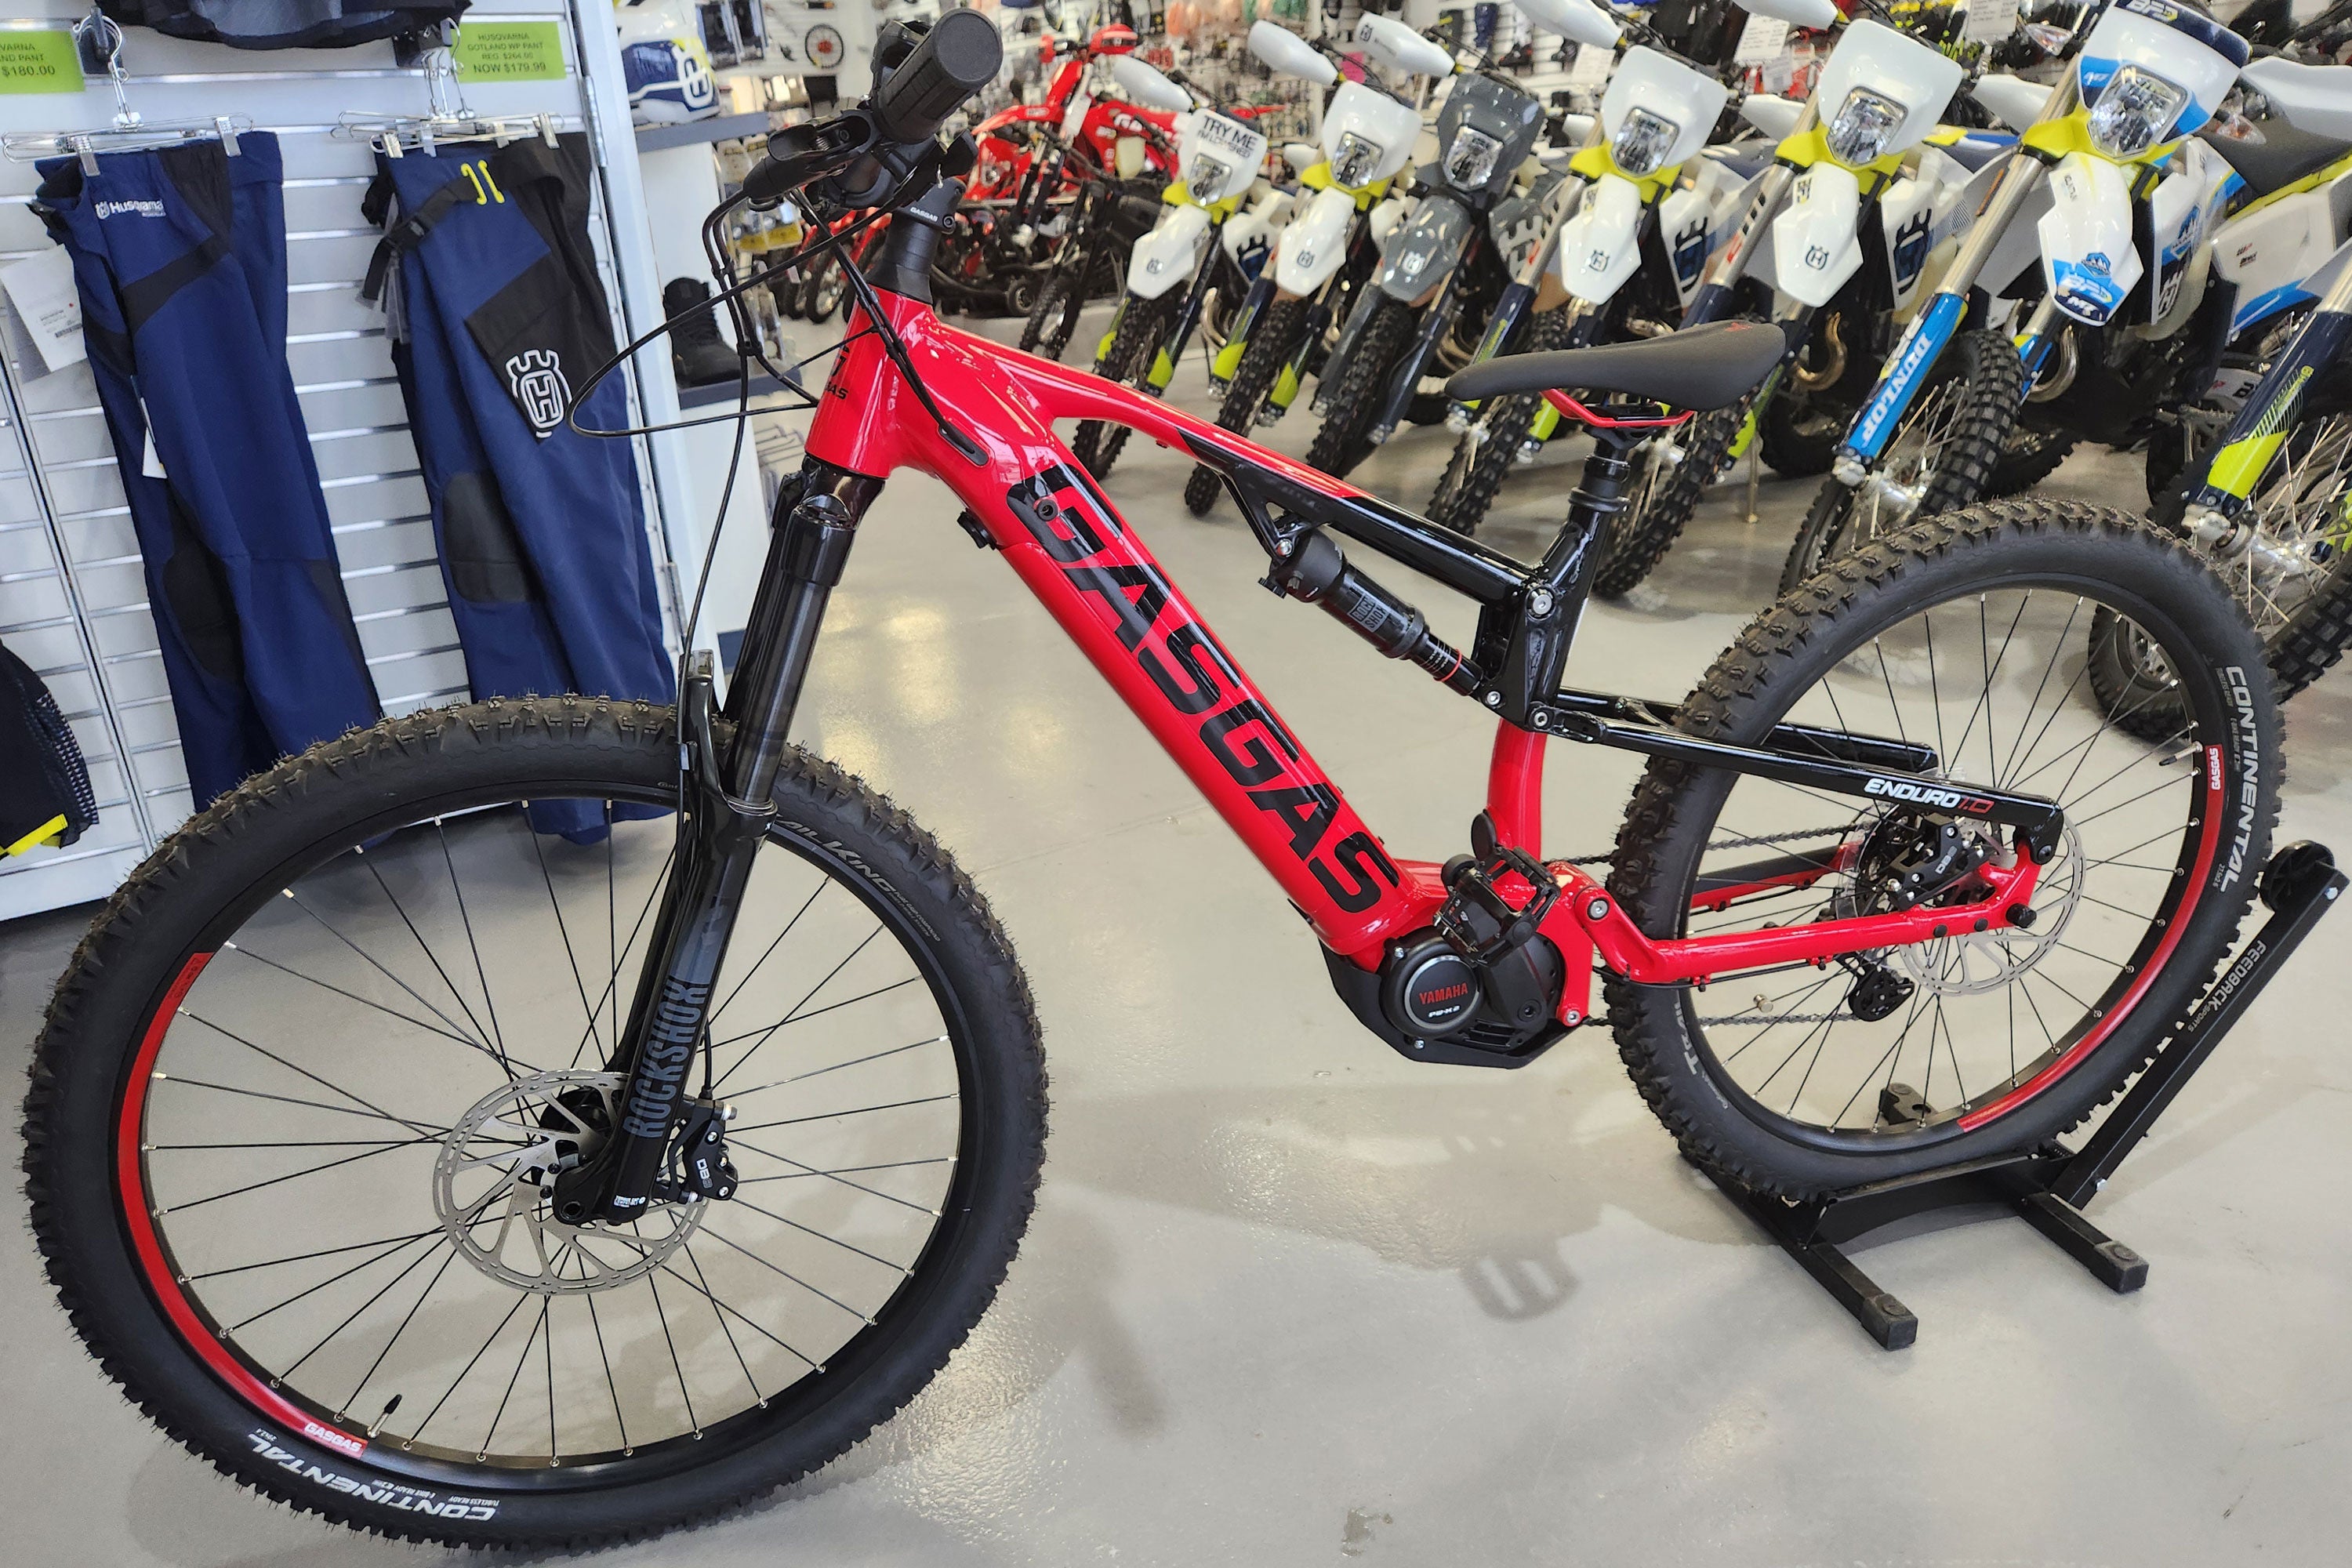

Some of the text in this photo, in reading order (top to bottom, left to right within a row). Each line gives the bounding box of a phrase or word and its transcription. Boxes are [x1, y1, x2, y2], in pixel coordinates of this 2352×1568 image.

[2, 65, 56, 78] $180.00
[18, 53, 44, 62] PANT
[474, 64, 502, 73] NOW
[1204, 115, 1260, 151] TRY ME
[1861, 332, 1933, 449] DUNLOP
[1006, 463, 1399, 913] GASGAS
[2209, 747, 2221, 790] GASGAS
[2220, 666, 2259, 892] CONTINENTAL
[1864, 778, 1962, 808] ENDURO
[1418, 982, 1468, 1005] YAMAHA
[2187, 939, 2267, 1033] FEEDBACK SPORTS
[622, 980, 709, 1138] ROCKSHOX
[303, 1421, 363, 1453] GASGAS
[247, 1433, 496, 1521] CONTINENTAL
